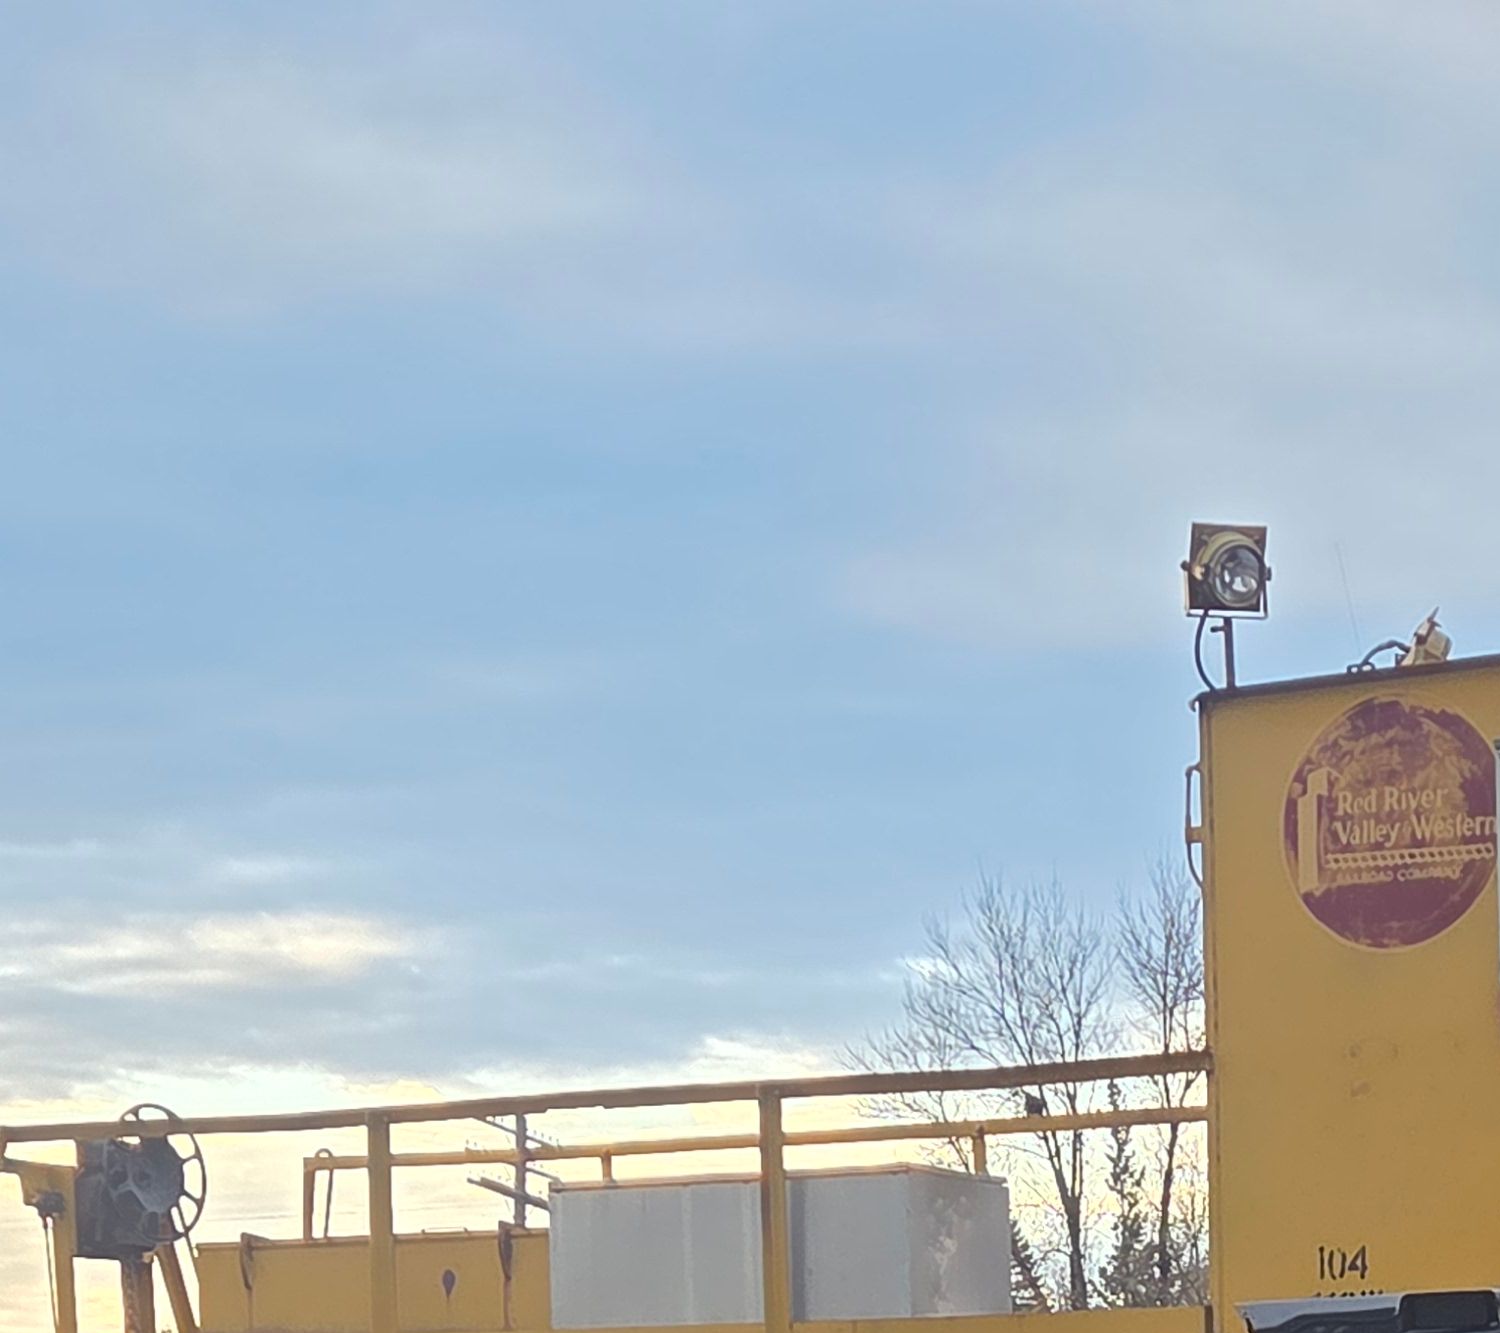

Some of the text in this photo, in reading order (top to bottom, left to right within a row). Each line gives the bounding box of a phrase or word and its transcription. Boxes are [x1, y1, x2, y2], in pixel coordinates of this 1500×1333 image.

[1336, 785, 1448, 816] Red River
[1332, 818, 1400, 848] Valley
[1411, 813, 1497, 842] Western
[1318, 1244, 1368, 1281] 104
